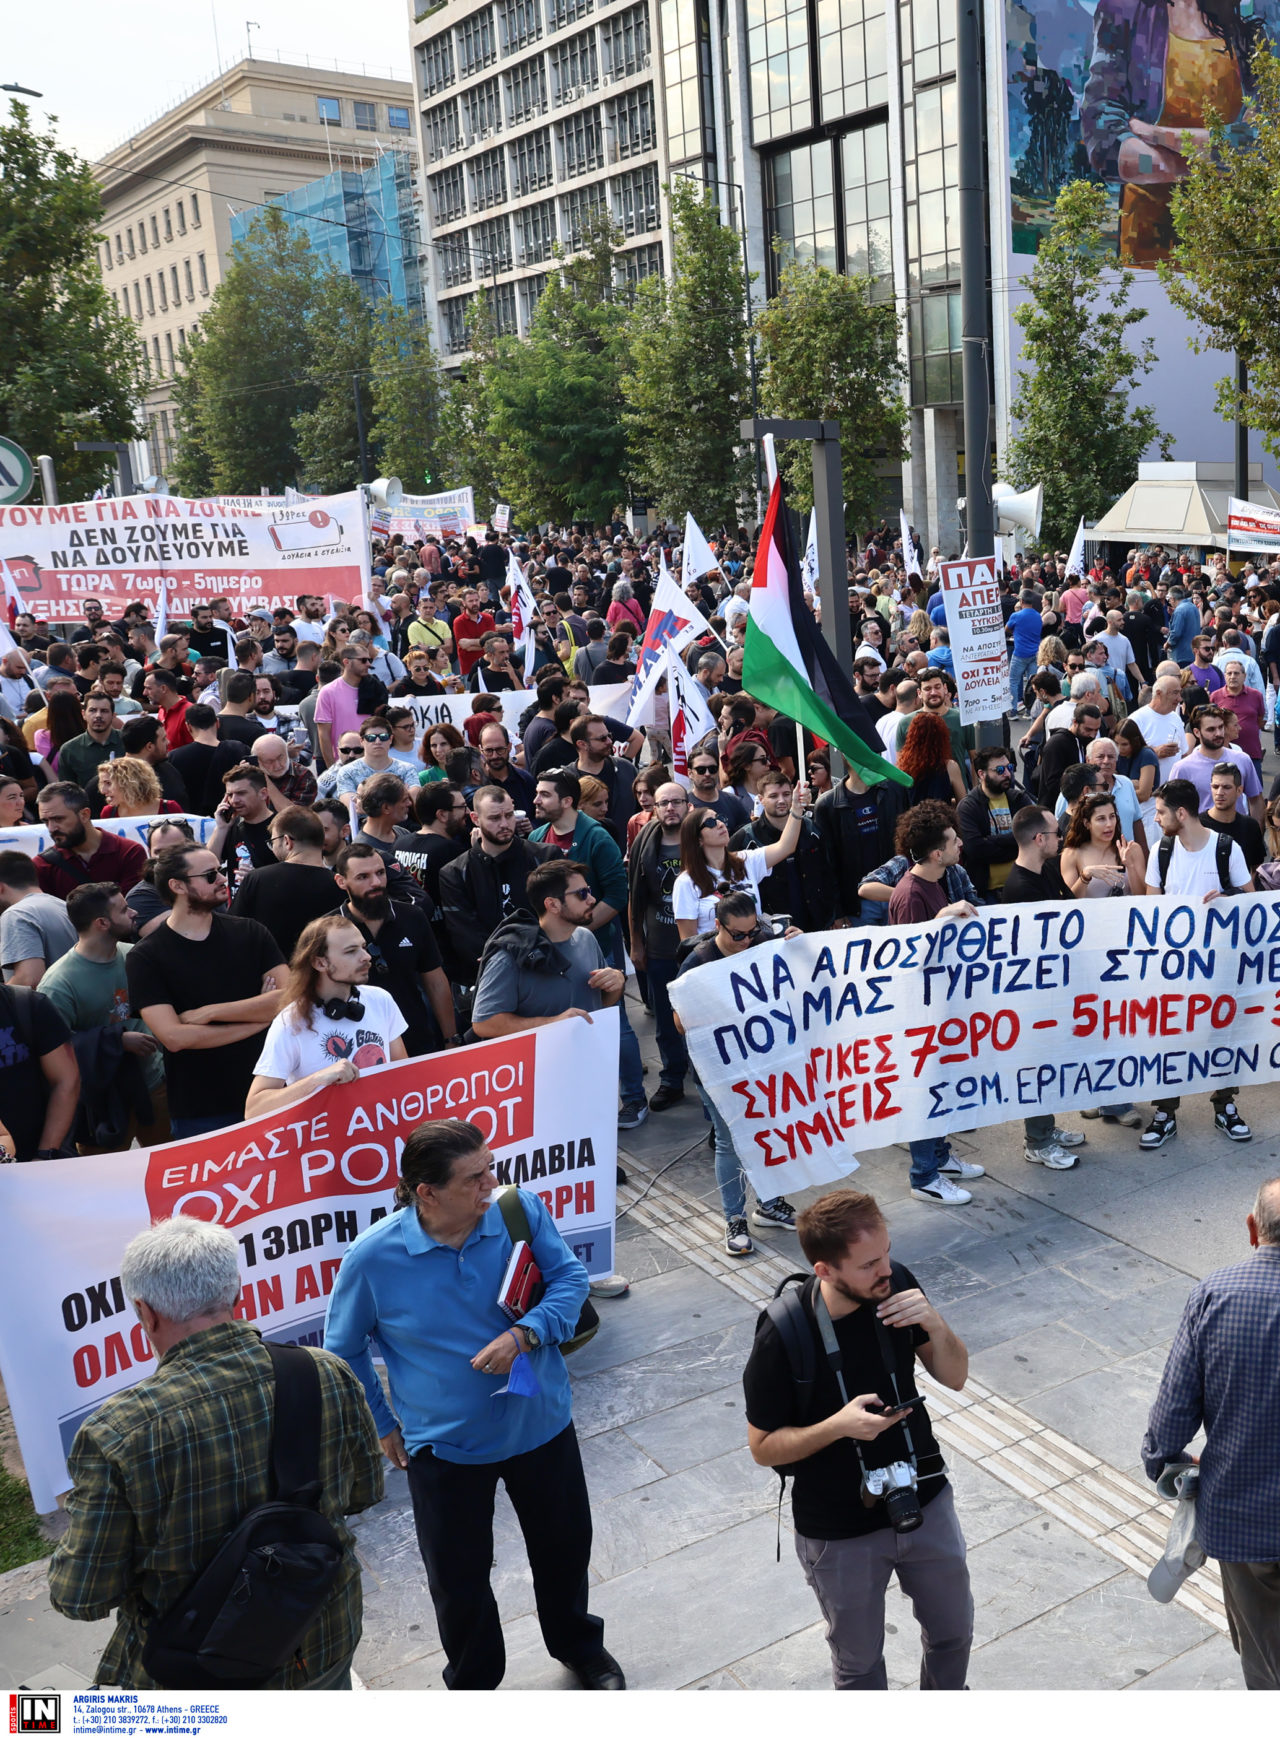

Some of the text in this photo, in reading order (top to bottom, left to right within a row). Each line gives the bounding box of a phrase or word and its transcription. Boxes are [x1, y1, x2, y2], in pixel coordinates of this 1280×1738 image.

[69, 522, 246, 548] ΔΕΝ ΖΟΥΜΕ ΓΙΑ
[95, 501, 138, 521] ΓΙΑ
[147, 499, 180, 518] ΝΑ
[51, 540, 250, 568] ΝΑ ΔΟΥΛΕΥΟΥΜΕ
[56, 573, 115, 591] ΤΩΡΑ
[122, 573, 177, 593] 7ωρο
[194, 573, 262, 593] 5ημερο
[962, 669, 979, 680] ΟΧΙ
[965, 677, 1000, 691] ΔΟΥΛΕΙΑ
[730, 953, 795, 1014] ΝΑ
[812, 914, 1020, 982] ΑΠΟΣΥΡΘΕΙ
[1034, 909, 1085, 950] ΤΟ
[713, 1001, 797, 1065] ΠΟΥ
[803, 975, 895, 1031] ΜΑΣ
[922, 954, 1070, 1006] ΓΥΡΙΖΕΙ
[1100, 948, 1215, 982] ΣΤΟΝ
[904, 1009, 1021, 1078] 7ΩΡΟ
[1072, 993, 1238, 1040] 5ΗΜΕΡΟ
[927, 1071, 1010, 1119] ΣΩΜ.
[1016, 1043, 1260, 1104] ΕΡΓΑΖΟΜΕΝΩΝ
[161, 1061, 524, 1190] ΕΙΜΑΣΤΕ ΑΝΘΡΩΠΟΙ
[171, 1096, 523, 1226] ΟΧΙ ΡΟΟΤ
[61, 1137, 596, 1333] ΟΧΙ 13ΩΡΗ ΚΛΑΒΙΑ
